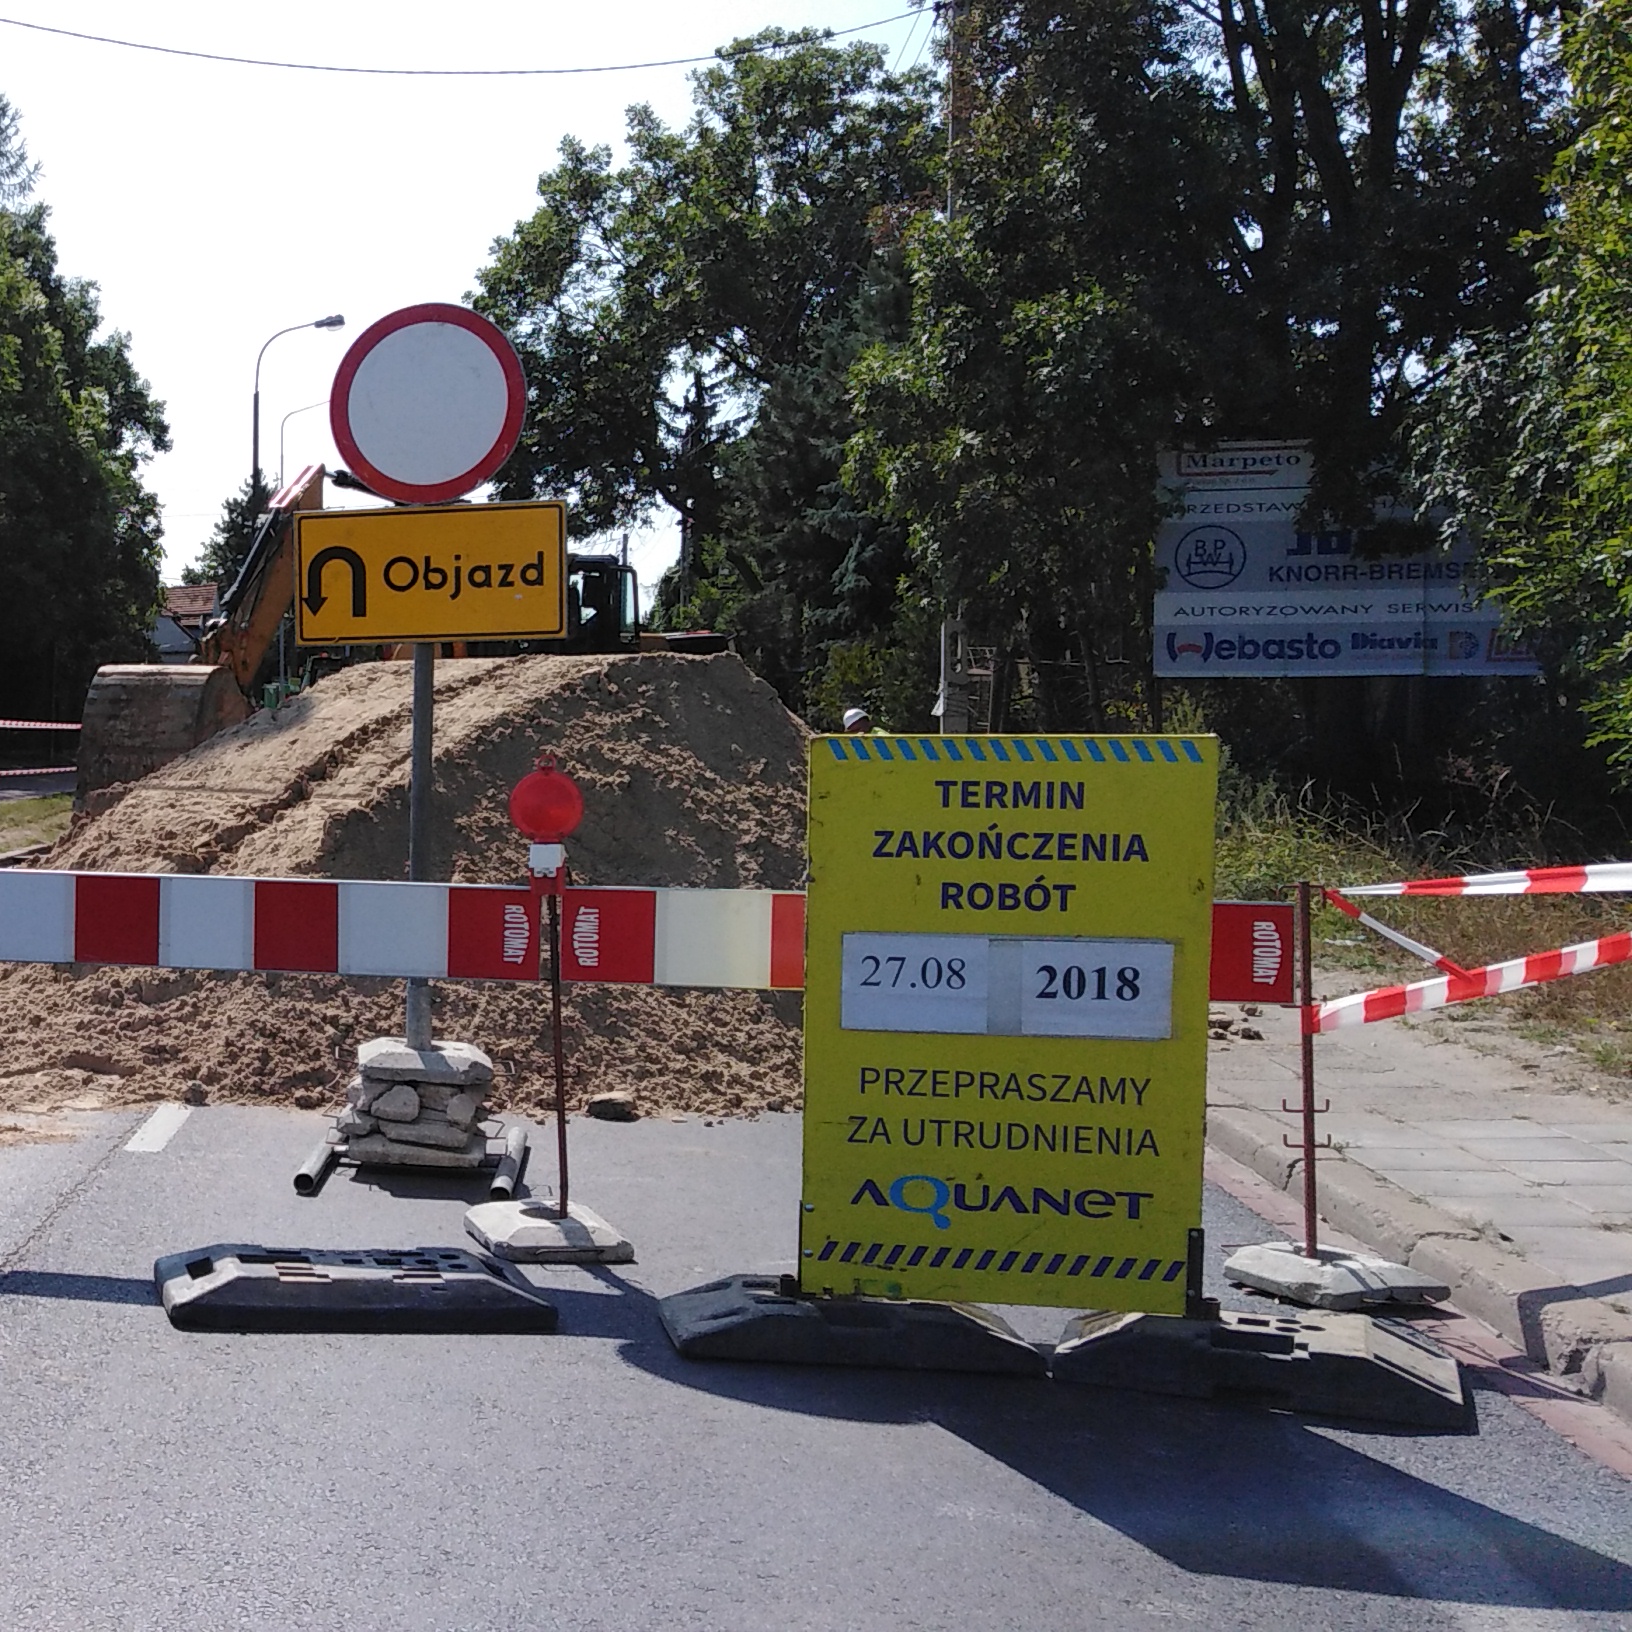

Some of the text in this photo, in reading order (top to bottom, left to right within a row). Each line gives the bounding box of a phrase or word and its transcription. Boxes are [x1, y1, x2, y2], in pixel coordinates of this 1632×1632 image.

[1186, 453, 1301, 470] Marpeto
[383, 551, 544, 600] Objazd
[1173, 601, 1474, 618] AUTORYZOWANY SERWIS
[1166, 632, 1438, 661] Webasto Diavia
[935, 779, 1085, 810] TERMIN
[872, 822, 1149, 862] ZAKOŃCZENIA
[940, 875, 1077, 912] ROBÓT
[503, 904, 530, 965] ROTOMAT
[572, 906, 599, 967] ROTOMAT
[1253, 920, 1283, 985] ROTOMAT
[860, 955, 1141, 1001] 27.08 2018
[859, 1067, 1151, 1106] PRZEPRASZAMY
[847, 1116, 1160, 1157] ZA UTRUDNIENIA
